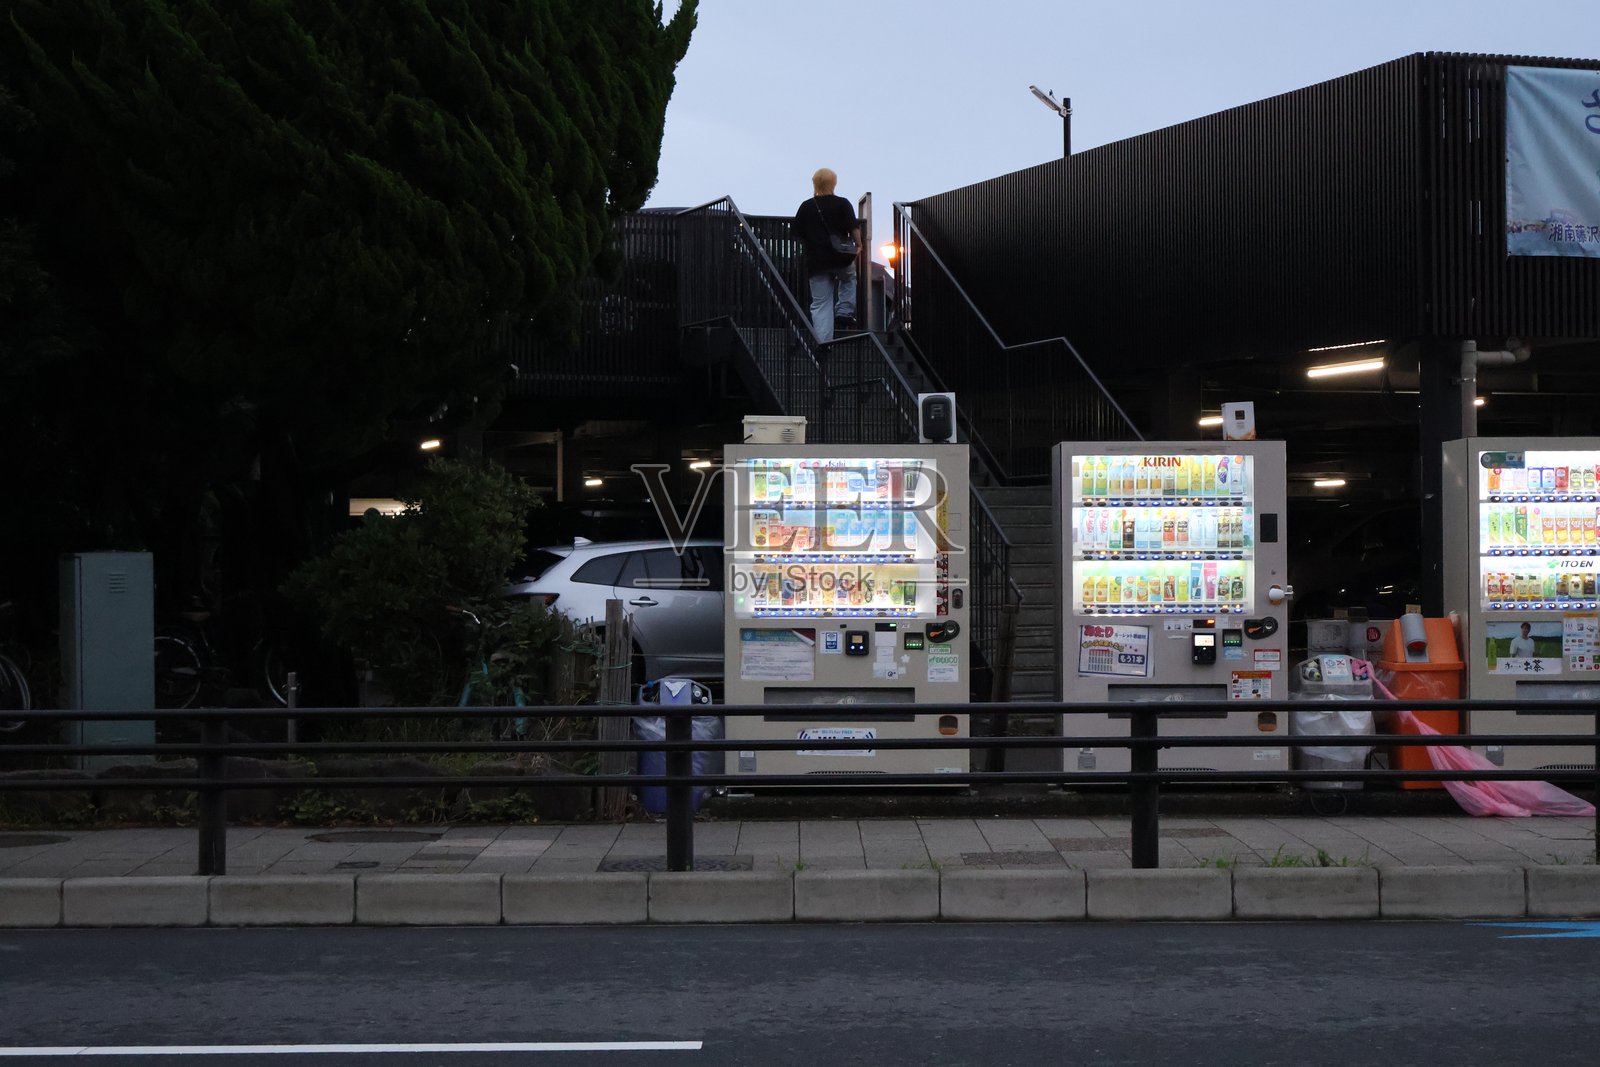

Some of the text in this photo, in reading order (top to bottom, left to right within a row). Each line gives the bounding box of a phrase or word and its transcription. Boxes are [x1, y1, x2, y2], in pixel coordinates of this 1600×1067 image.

[1143, 456, 1182, 468] KIRIN
[1560, 560, 1594, 568] ITO EN
